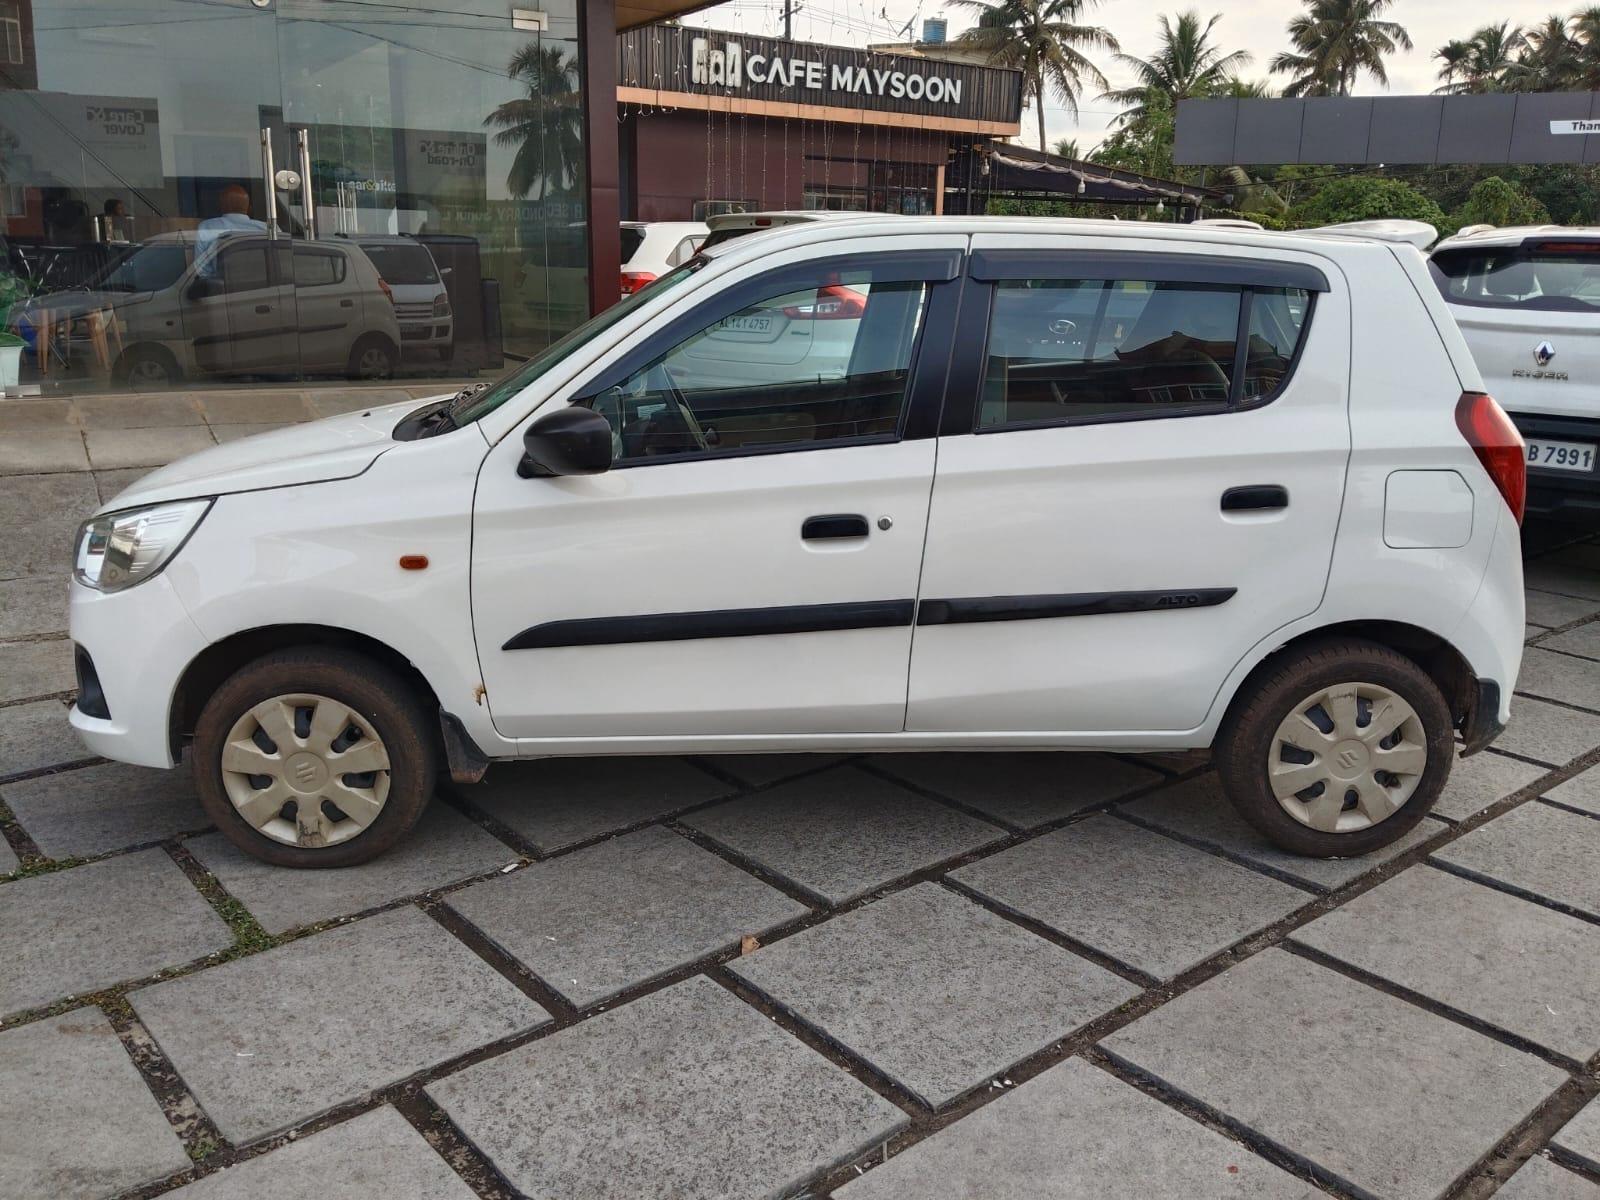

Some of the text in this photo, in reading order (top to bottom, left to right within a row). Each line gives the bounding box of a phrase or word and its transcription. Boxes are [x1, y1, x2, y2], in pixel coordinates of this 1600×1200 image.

[747, 54, 962, 104] CAFE MAYSOON
[1544, 446, 1593, 468] 7991
[1153, 593, 1200, 606] ALTO
